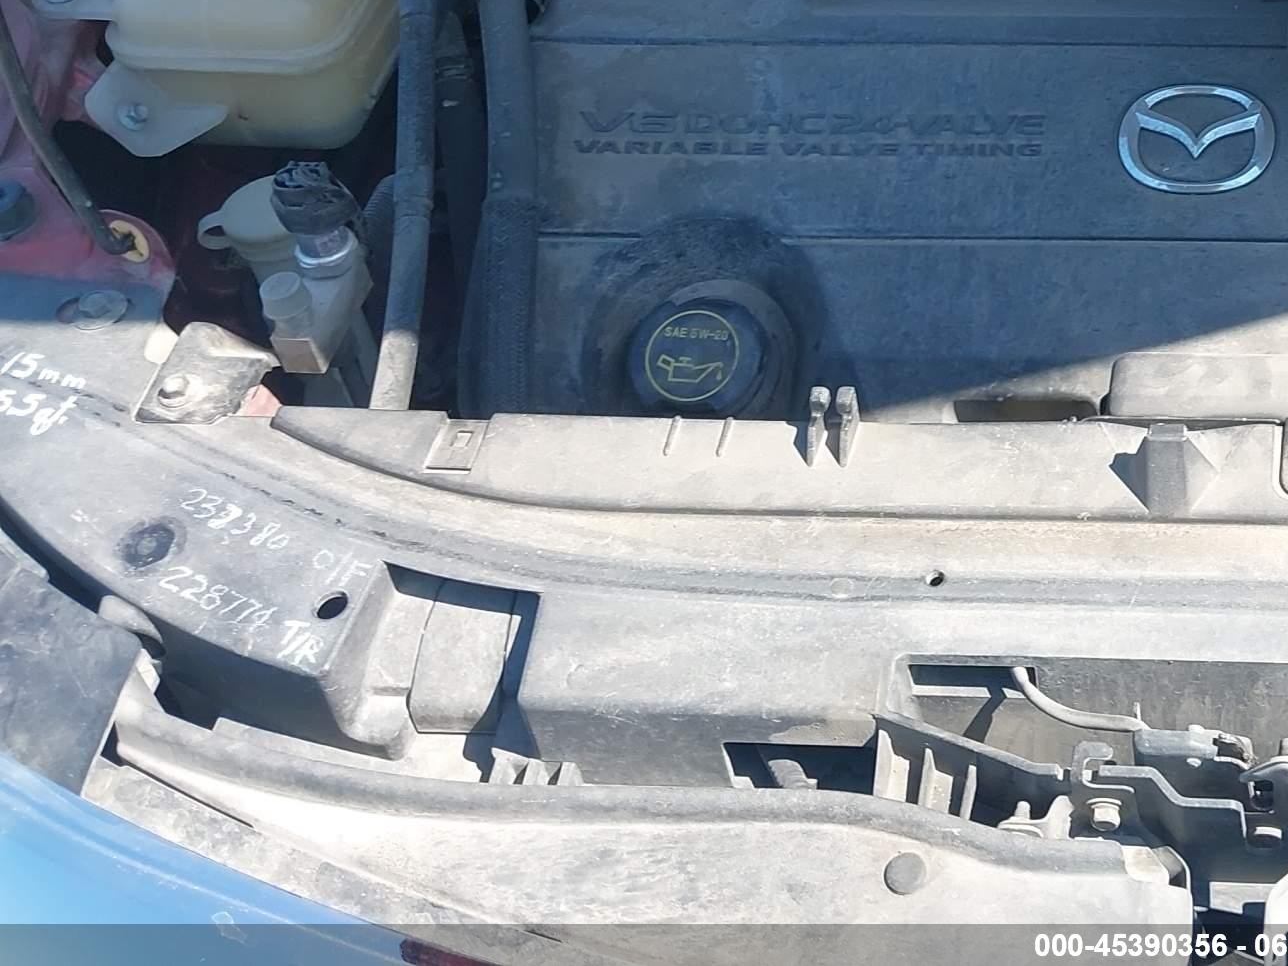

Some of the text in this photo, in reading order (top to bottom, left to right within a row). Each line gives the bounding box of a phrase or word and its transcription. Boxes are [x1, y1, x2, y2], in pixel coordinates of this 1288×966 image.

[579, 111, 678, 133] V6
[685, 112, 826, 134] DOHC
[573, 139, 1042, 157] VARIABLE VALVE TIMING
[663, 326, 688, 338] SAE
